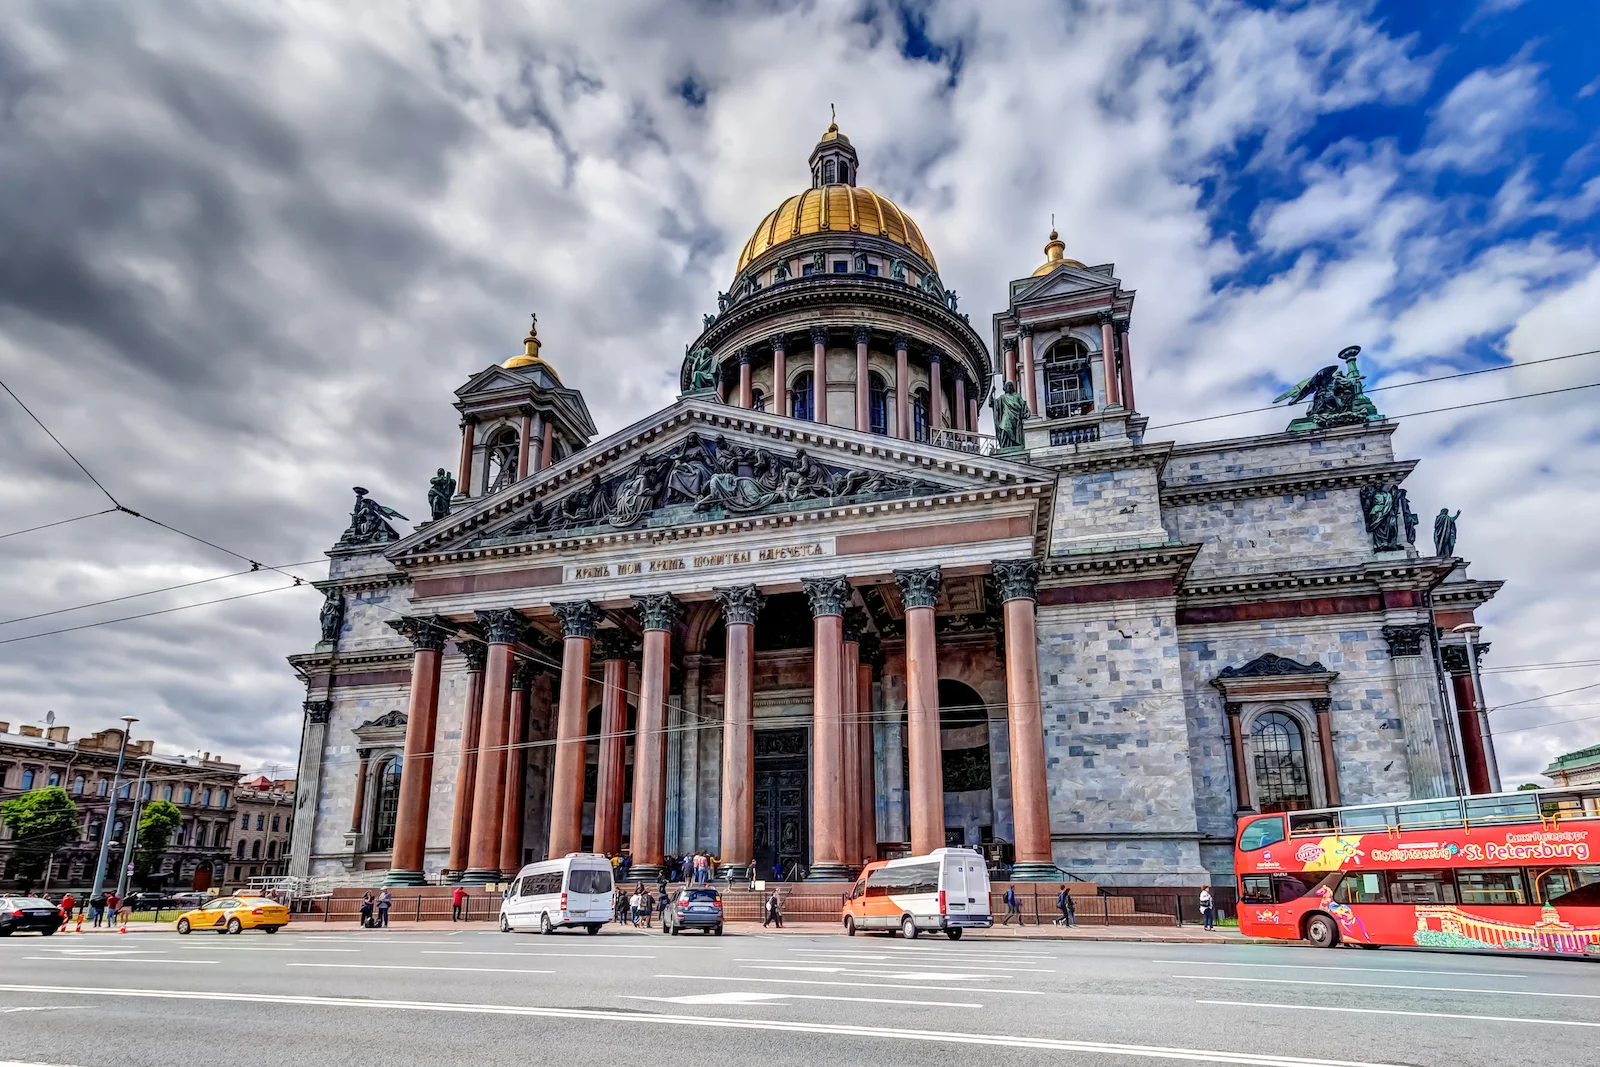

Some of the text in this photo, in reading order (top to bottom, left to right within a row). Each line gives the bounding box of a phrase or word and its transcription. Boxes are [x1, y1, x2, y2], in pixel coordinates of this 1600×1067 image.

[1297, 848, 1324, 861] OFFICIAL
[1464, 841, 1589, 861] St Petersburg
